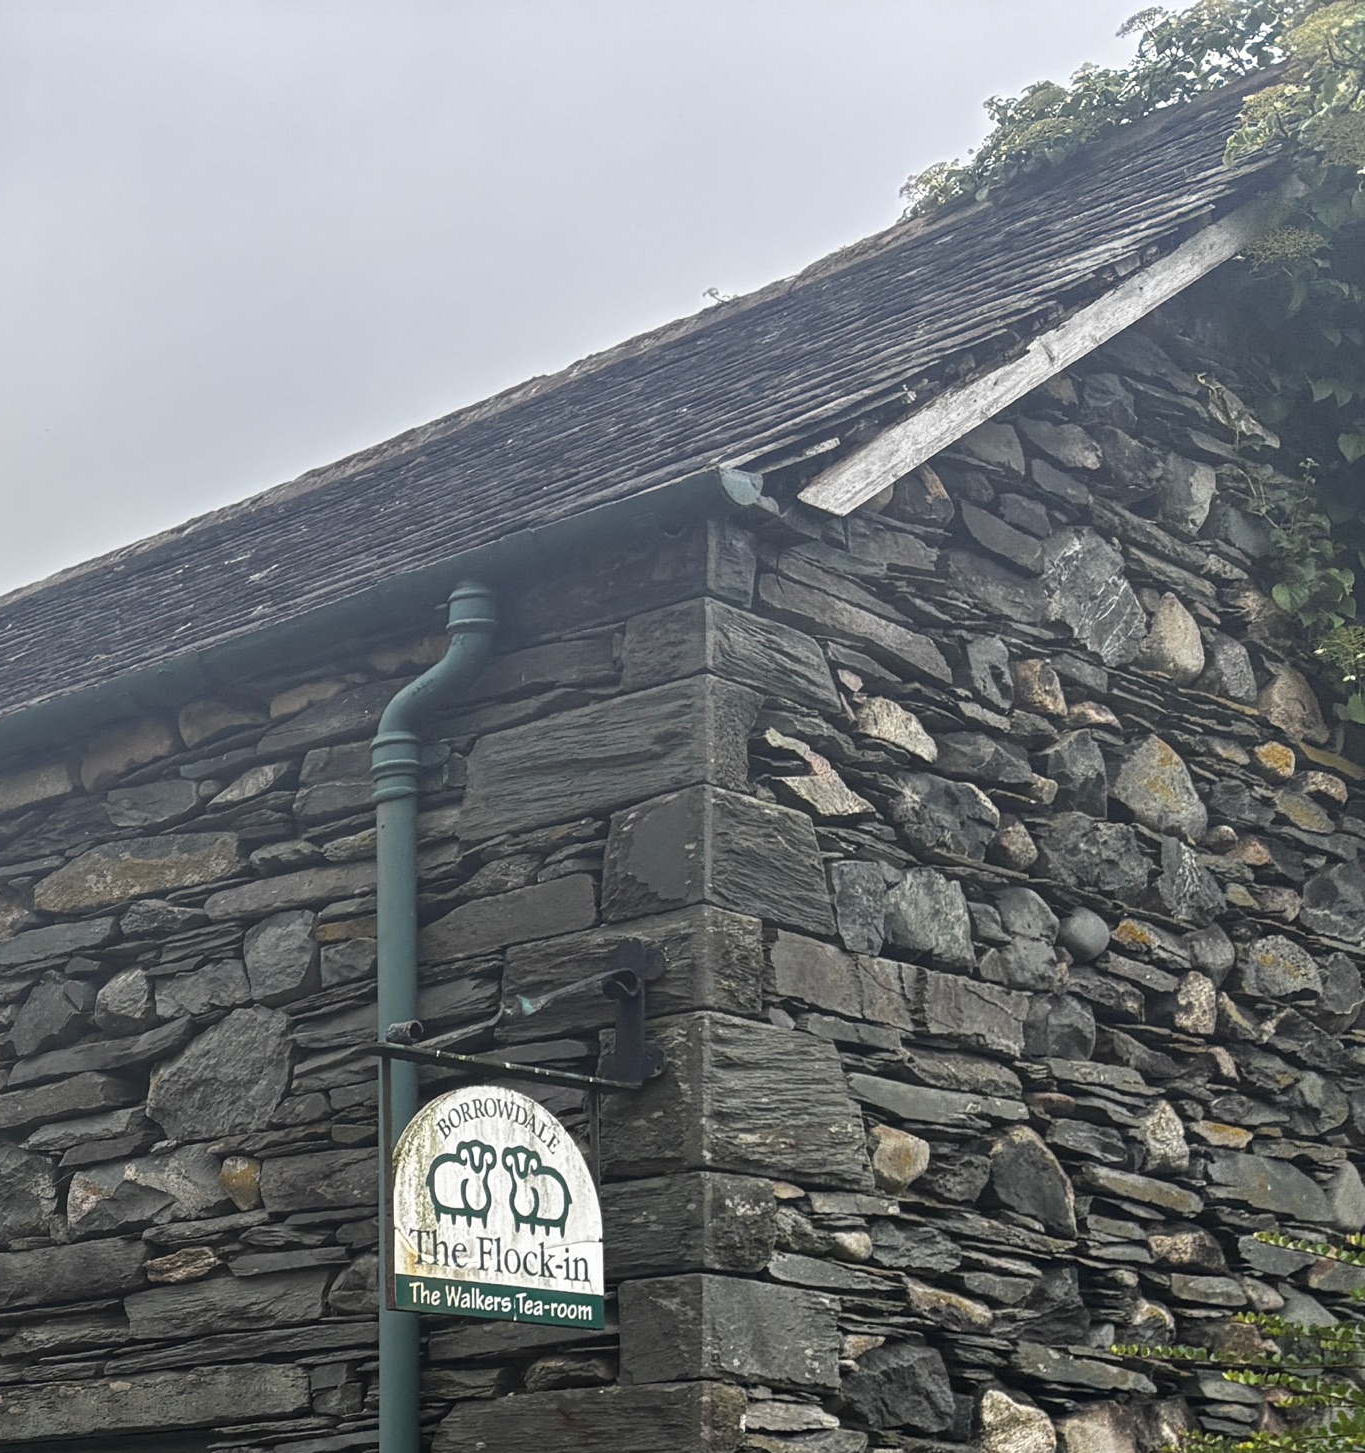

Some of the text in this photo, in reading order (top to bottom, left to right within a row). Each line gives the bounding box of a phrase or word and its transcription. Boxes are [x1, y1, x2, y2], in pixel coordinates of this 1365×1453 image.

[436, 1097, 561, 1155] BORROWDALE
[408, 1228, 591, 1283] The Flock-in
[408, 1281, 593, 1321] The Walkers Tea-room
